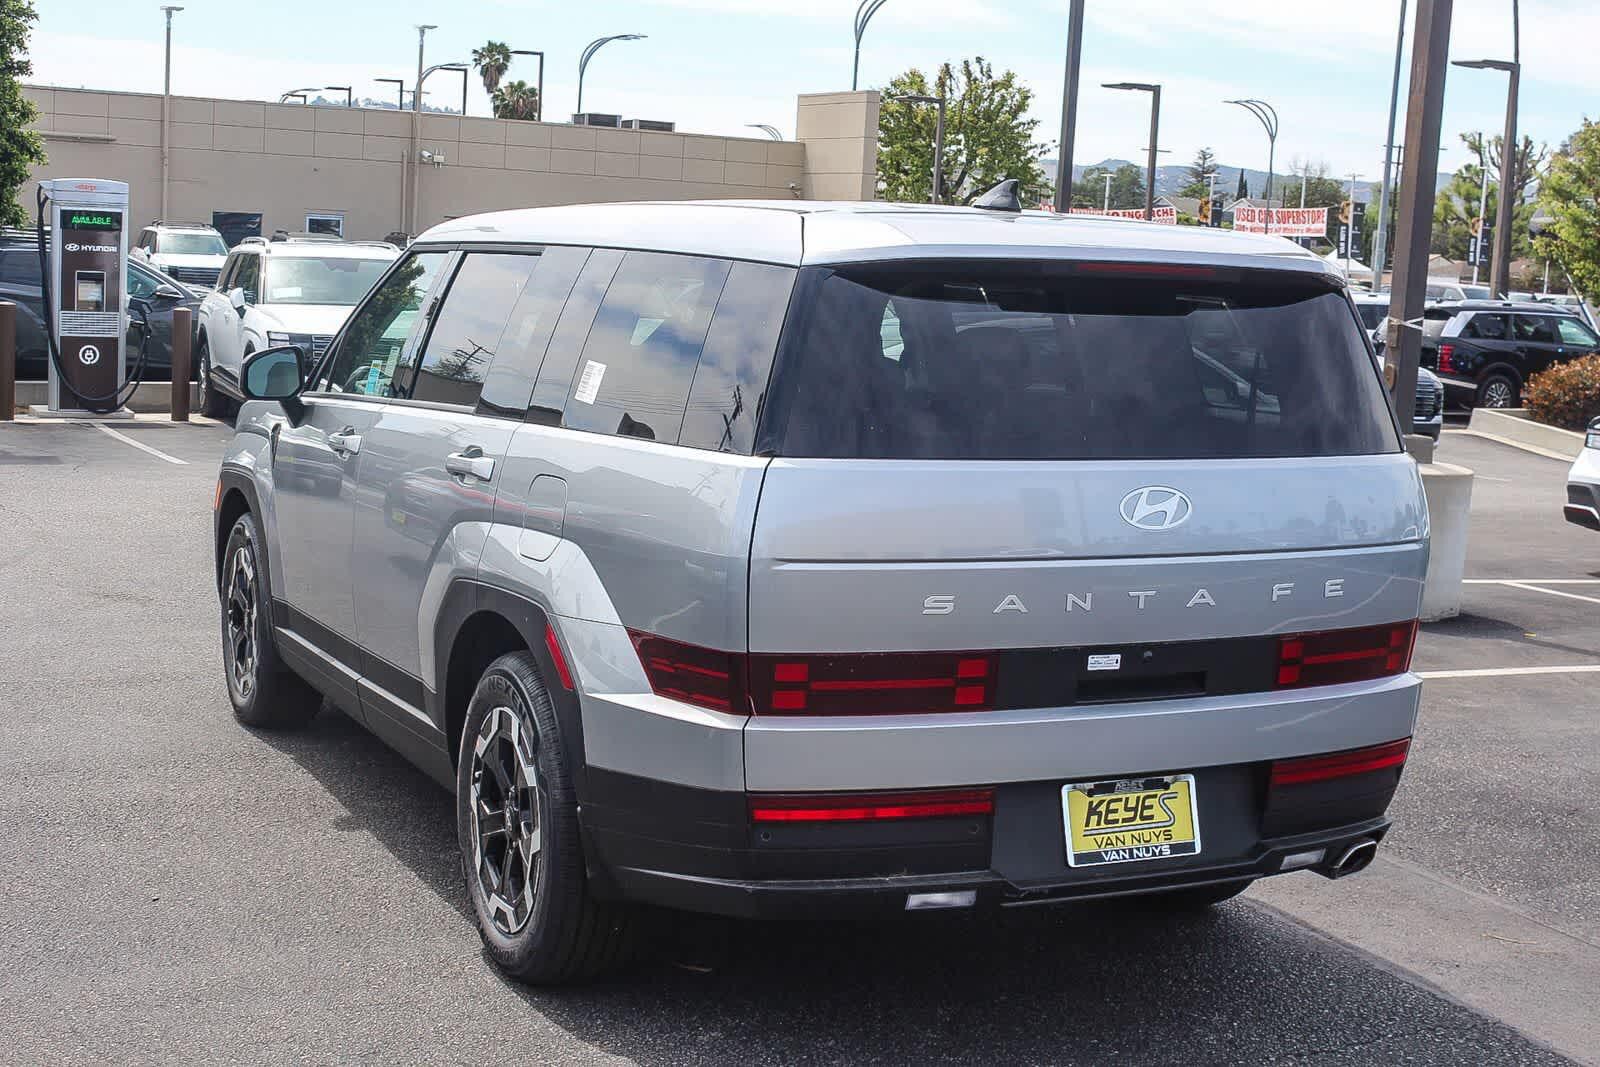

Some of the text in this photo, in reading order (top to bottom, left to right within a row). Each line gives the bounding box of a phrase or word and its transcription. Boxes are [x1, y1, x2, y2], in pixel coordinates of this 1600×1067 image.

[72, 215, 112, 225] AVAILABLE
[1122, 207, 1175, 220] ENGCHE
[1236, 207, 1256, 223] USED
[1275, 209, 1326, 225] SUPERSTORE
[81, 244, 117, 252] HYUNDAI
[922, 578, 1345, 615] SANTA FE
[1084, 791, 1178, 831] KEYES
[1094, 829, 1173, 849] VAN NUYS
[1101, 845, 1171, 862] VAN NUYS
